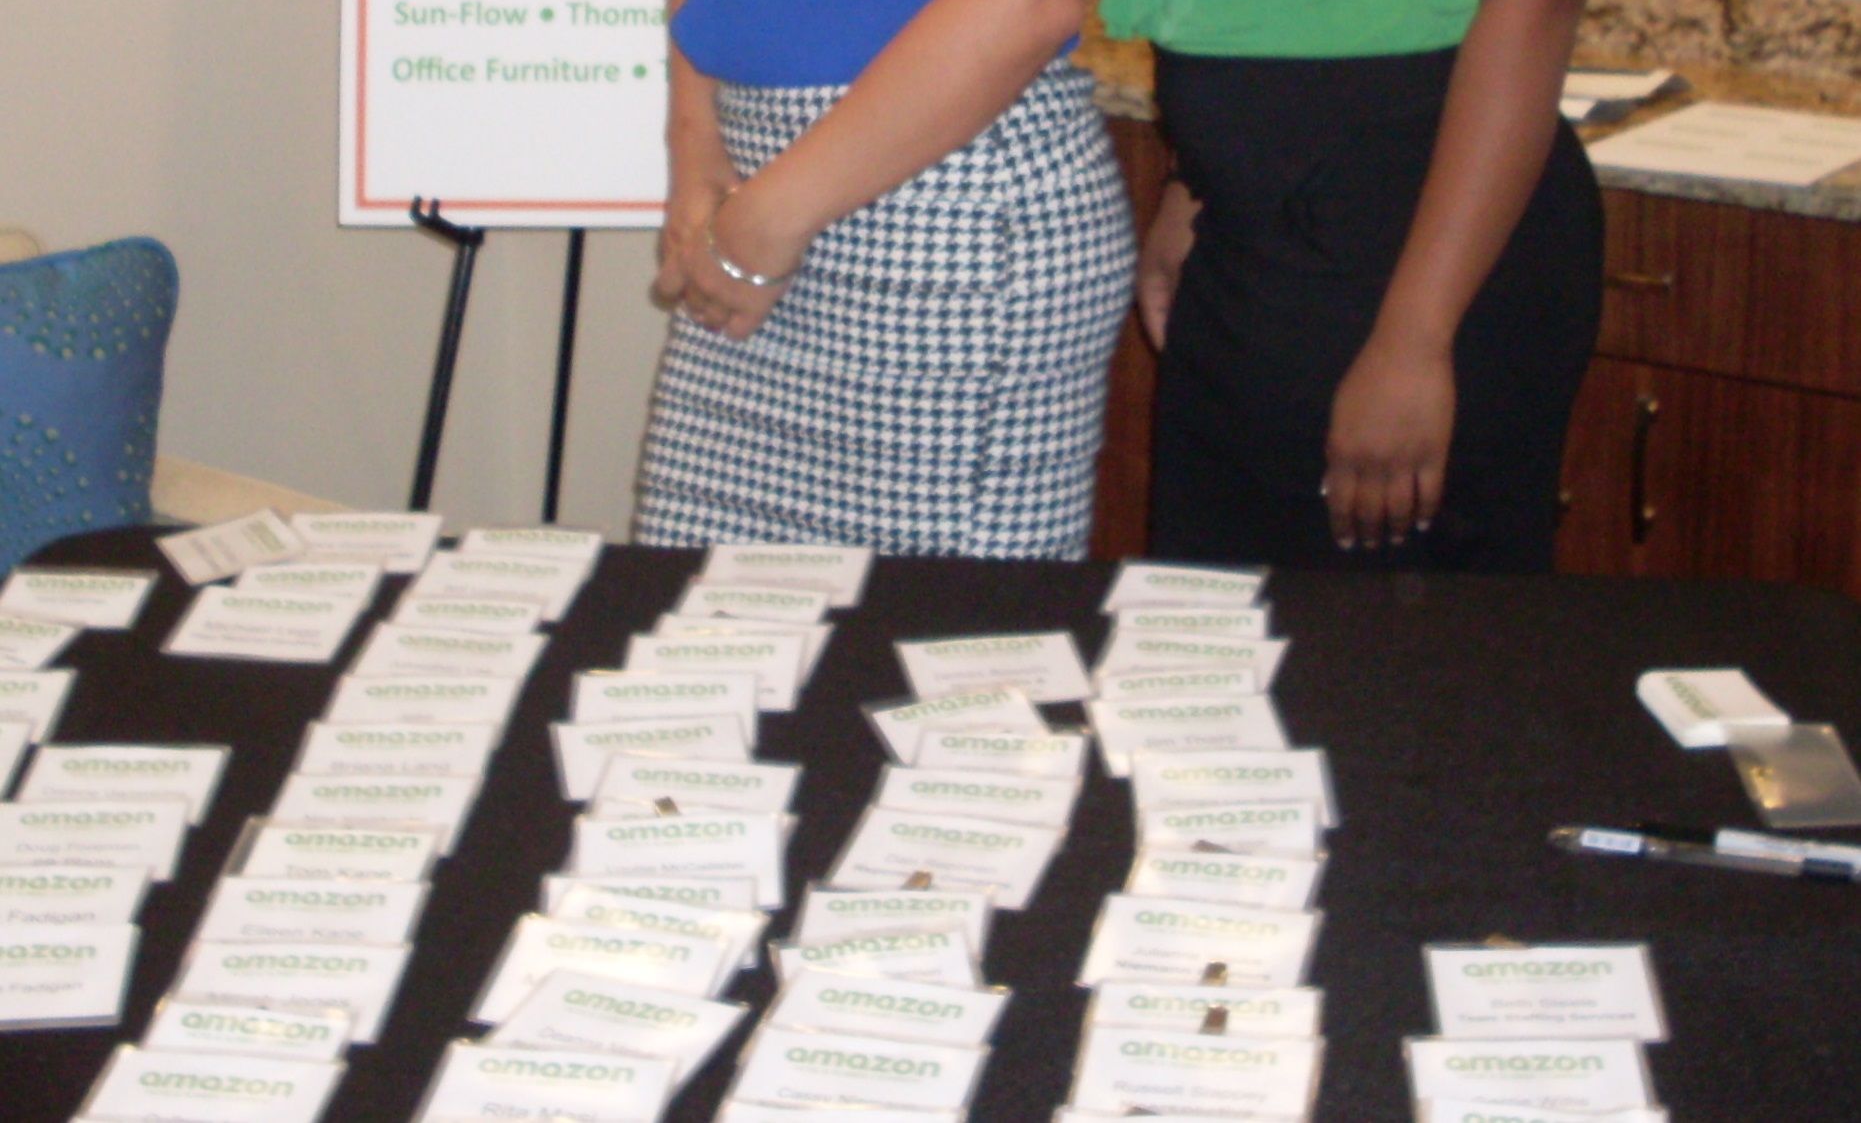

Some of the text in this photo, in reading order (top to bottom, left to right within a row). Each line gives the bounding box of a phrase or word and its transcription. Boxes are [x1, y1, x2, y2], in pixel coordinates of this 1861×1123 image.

[394, 0, 528, 26] Sun-Flow
[391, 56, 476, 83] Office
[485, 57, 620, 83] Furniture
[222, 595, 334, 612] amazon
[703, 590, 815, 606] amazon
[417, 602, 528, 618] amazon
[1134, 613, 1253, 627] amazon
[398, 634, 513, 653] amazon
[655, 643, 776, 658] amazon
[924, 637, 1044, 656] amazon
[1137, 639, 1254, 658] amazon
[603, 683, 728, 698] amazon
[1119, 672, 1242, 690] amazon
[365, 684, 488, 698] amazon
[891, 690, 1011, 722] amazon
[1118, 703, 1242, 720] amazon
[336, 731, 464, 745] amazon
[584, 726, 713, 746] amazon
[941, 734, 1068, 752] amazon
[62, 759, 191, 772] amazon
[1161, 766, 1293, 780] amazon
[631, 767, 762, 787] amazon
[312, 784, 443, 799] amazon
[910, 779, 1043, 801] amazon
[20, 811, 155, 826] amazon
[1164, 807, 1299, 828] amazon
[606, 820, 746, 841] amazon
[891, 821, 1024, 849] amazon
[284, 834, 420, 849] amazon
[1149, 857, 1287, 883] amazon
[245, 888, 387, 906] amazon
[827, 898, 970, 912] amazon
[1135, 910, 1280, 935] amazon
[546, 933, 691, 961] amazon
[801, 933, 949, 961] amazon
[222, 954, 368, 973] amazon
[1462, 960, 1613, 977] amazon
[563, 988, 698, 1026] amazon
[818, 988, 965, 1019] amazon
[181, 1011, 331, 1040] amazon
[785, 1047, 942, 1077] amazon
[1120, 1040, 1278, 1065] amazon
[478, 1058, 636, 1084] amazon
[1445, 1055, 1604, 1071] amazon
[139, 1070, 295, 1097] amazon
